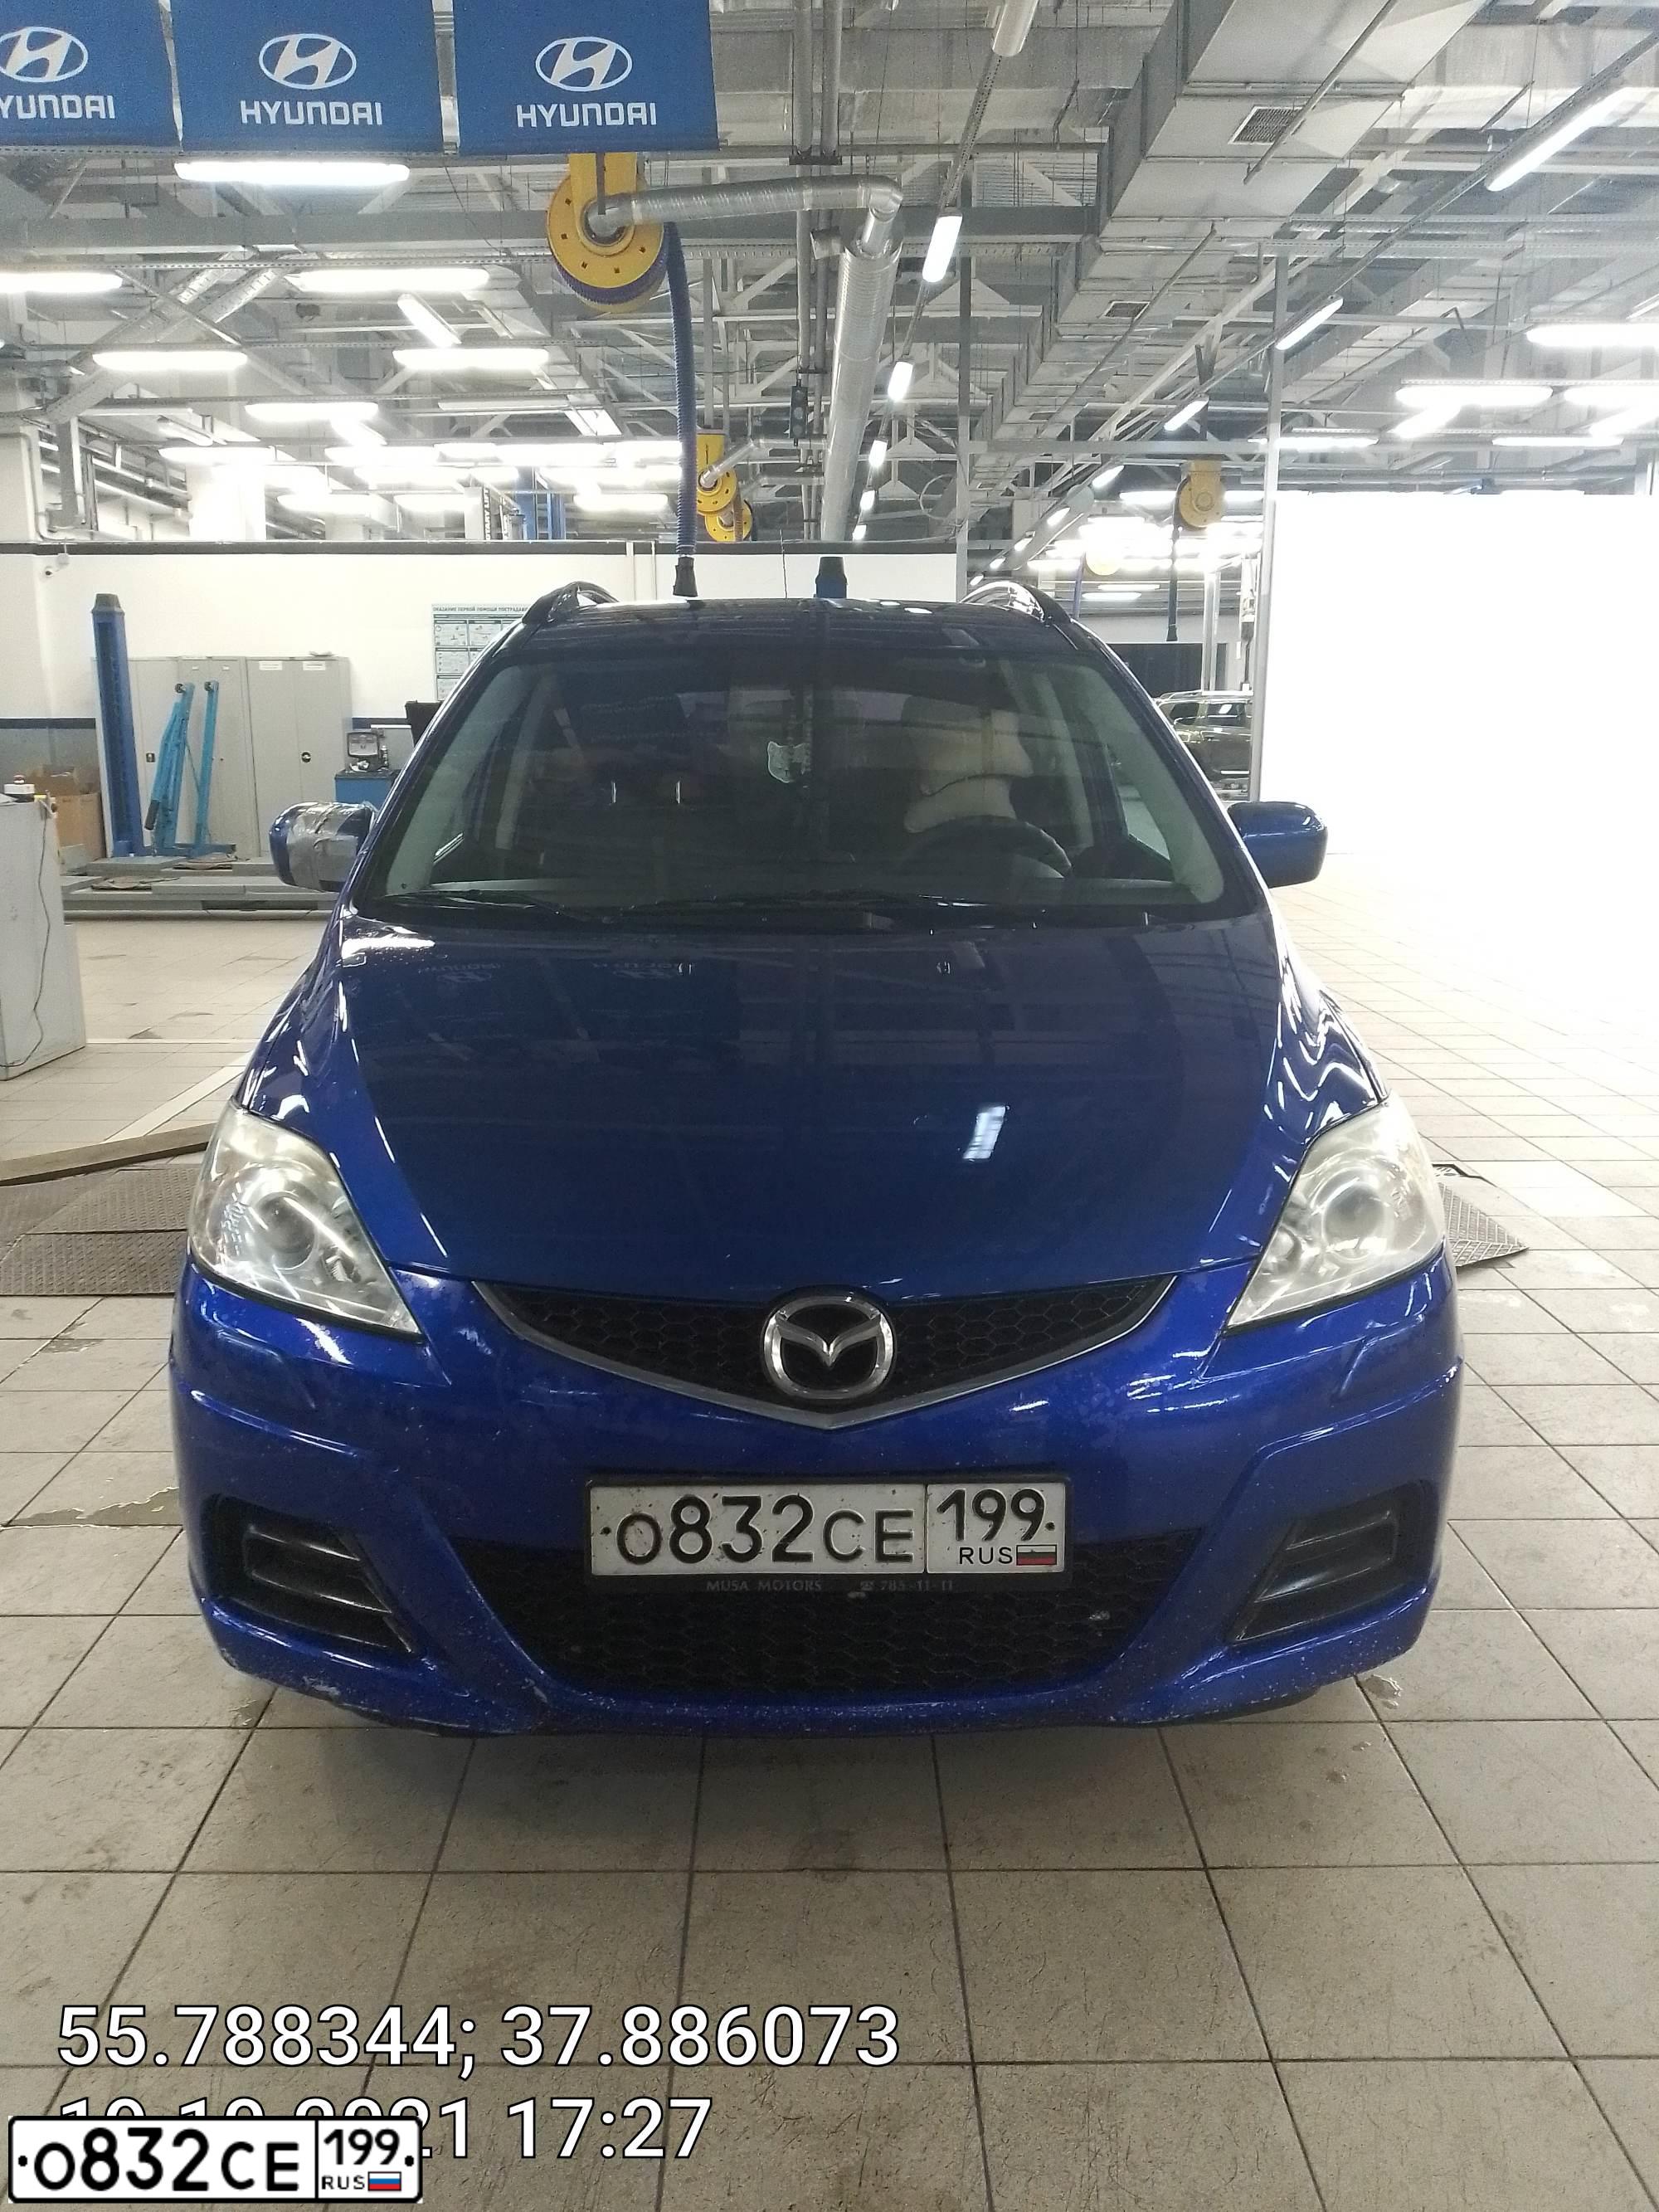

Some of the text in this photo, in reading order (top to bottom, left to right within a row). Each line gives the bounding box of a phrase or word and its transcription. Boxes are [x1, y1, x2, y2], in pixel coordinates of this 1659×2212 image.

[240, 100, 383, 125] HYUNDAI
[516, 102, 657, 128] HYUNDAI
[937, 1488, 1046, 1542] 199
[959, 1546, 1013, 1565] RUS
[706, 1580, 749, 1591] MUSA
[757, 1580, 822, 1591] MOTORS
